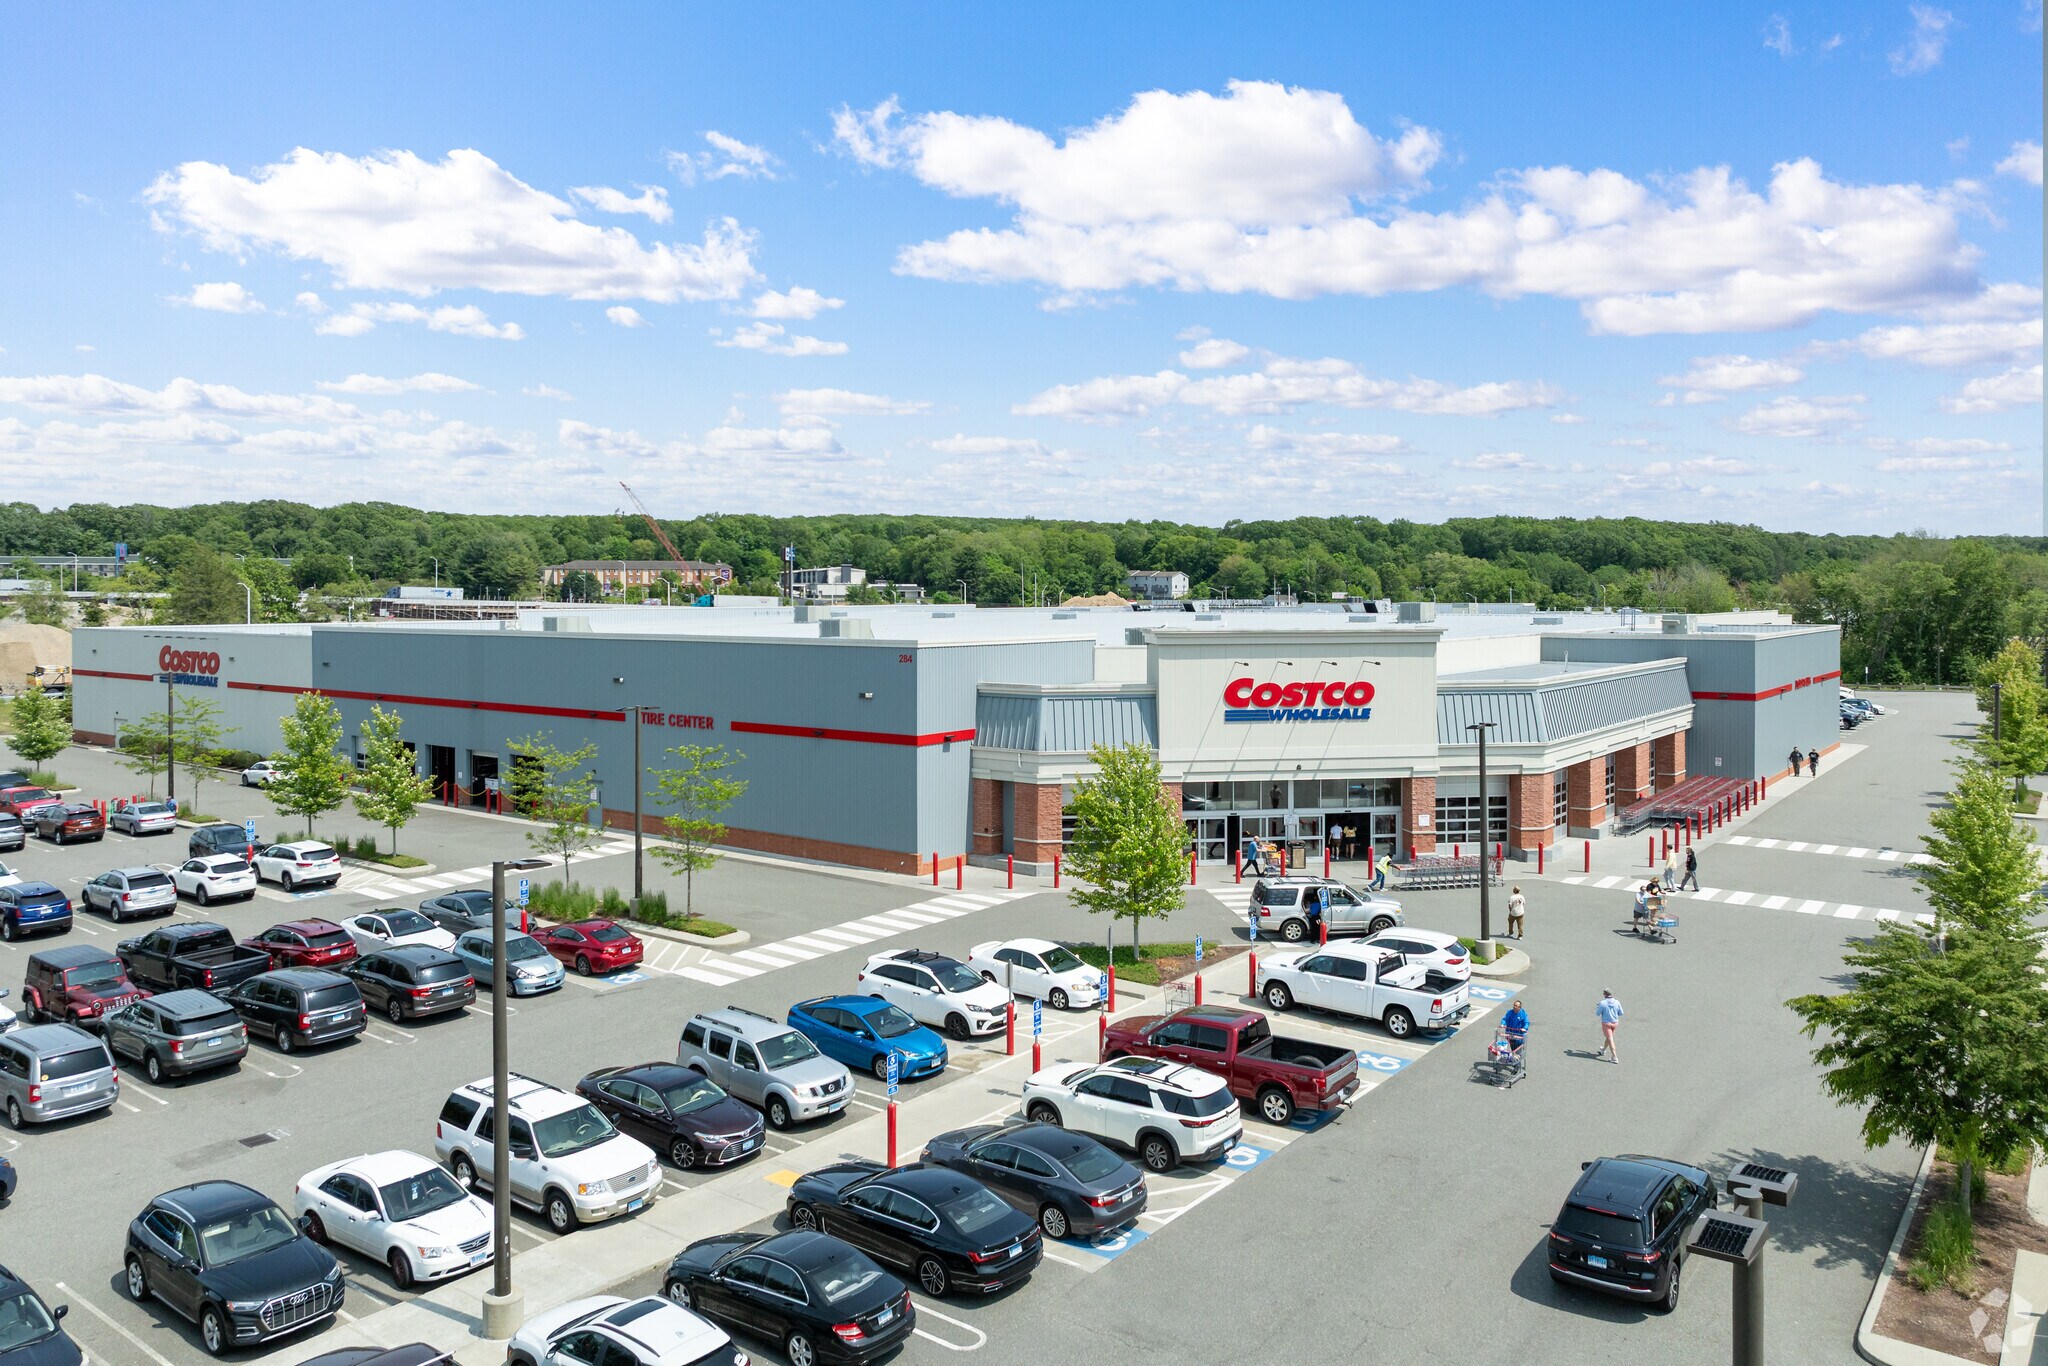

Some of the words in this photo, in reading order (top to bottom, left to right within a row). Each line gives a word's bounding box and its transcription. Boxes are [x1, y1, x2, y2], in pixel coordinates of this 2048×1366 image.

[159, 645, 220, 675] COSTCO
[899, 654, 912, 663] 284
[174, 673, 218, 688] WHOLESALE
[1224, 677, 1375, 708] COSTCO
[640, 711, 665, 726] TIRE
[668, 713, 714, 730] CENTER
[1268, 708, 1371, 721] WHOLESALE
